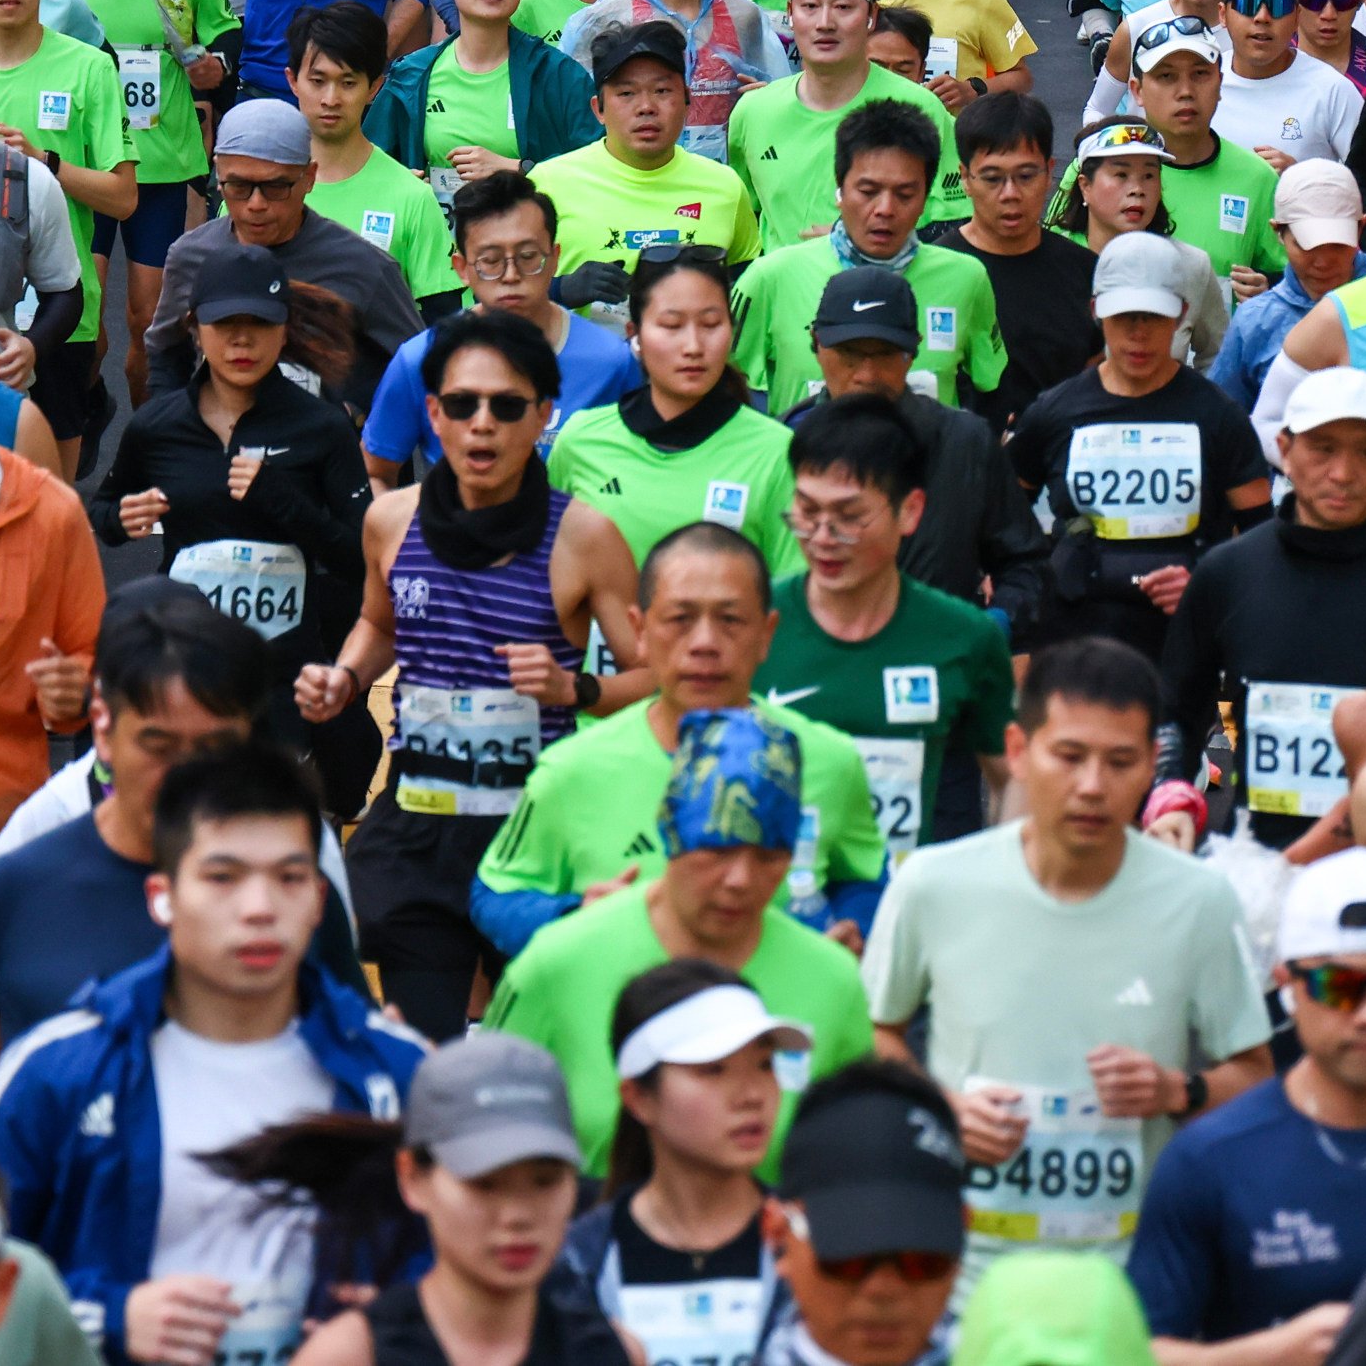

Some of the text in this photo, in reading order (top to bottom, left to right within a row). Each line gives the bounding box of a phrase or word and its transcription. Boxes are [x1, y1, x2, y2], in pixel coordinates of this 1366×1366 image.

[125, 82, 156, 108] 68
[1073, 468, 1196, 506] B2205
[1255, 733, 1345, 778] B12
